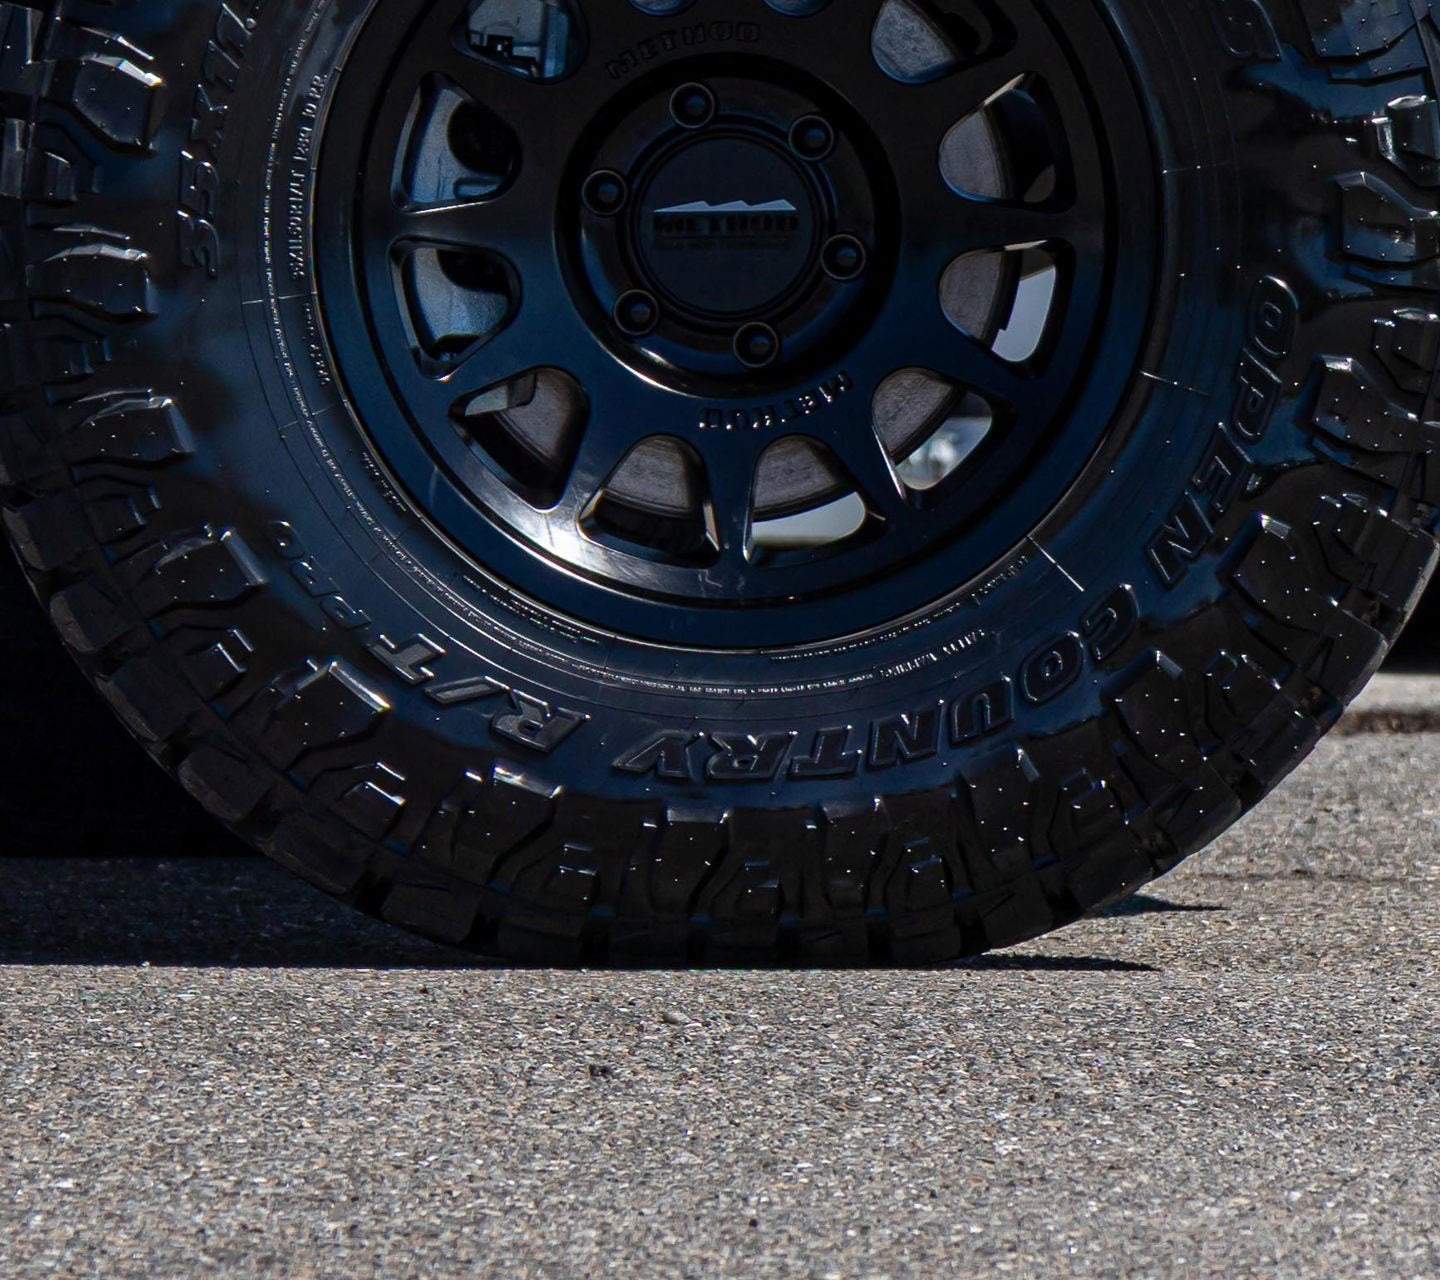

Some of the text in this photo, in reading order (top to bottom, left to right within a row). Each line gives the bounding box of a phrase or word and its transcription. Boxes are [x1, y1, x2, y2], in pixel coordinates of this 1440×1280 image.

[606, 20, 761, 81] METHOD
[1140, 273, 1301, 589] OPEN
[363, 632, 592, 754] R/T
[609, 583, 1140, 783] COUNTRY
